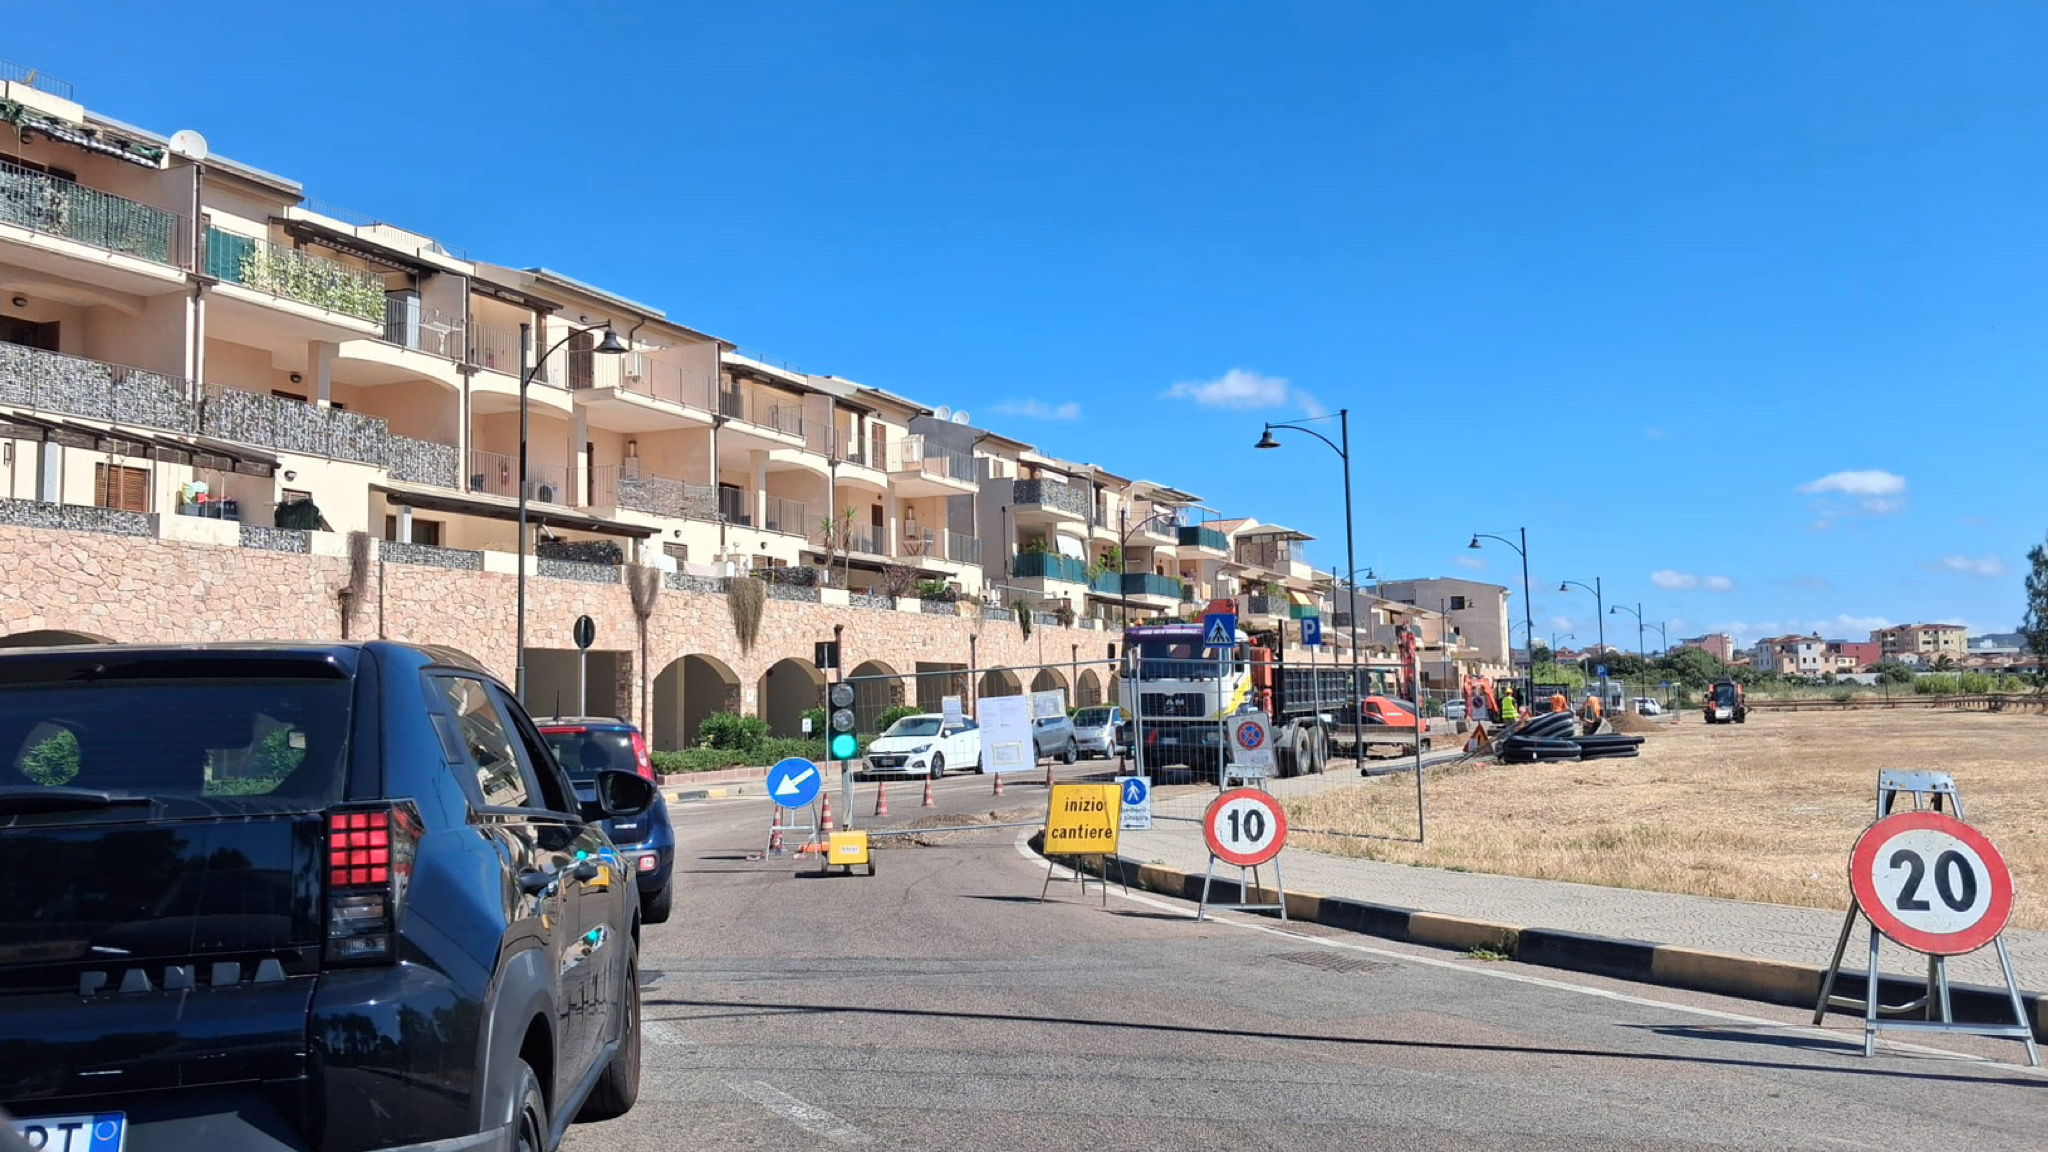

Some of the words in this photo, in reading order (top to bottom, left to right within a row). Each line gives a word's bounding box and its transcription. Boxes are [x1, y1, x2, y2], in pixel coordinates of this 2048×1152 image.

[1303, 618, 1316, 642] P
[1064, 796, 1104, 812] inizio
[1051, 823, 1113, 839] cantiere
[1228, 808, 1266, 842] 10
[1889, 848, 1978, 913] 20
[79, 958, 287, 997] PANDA
